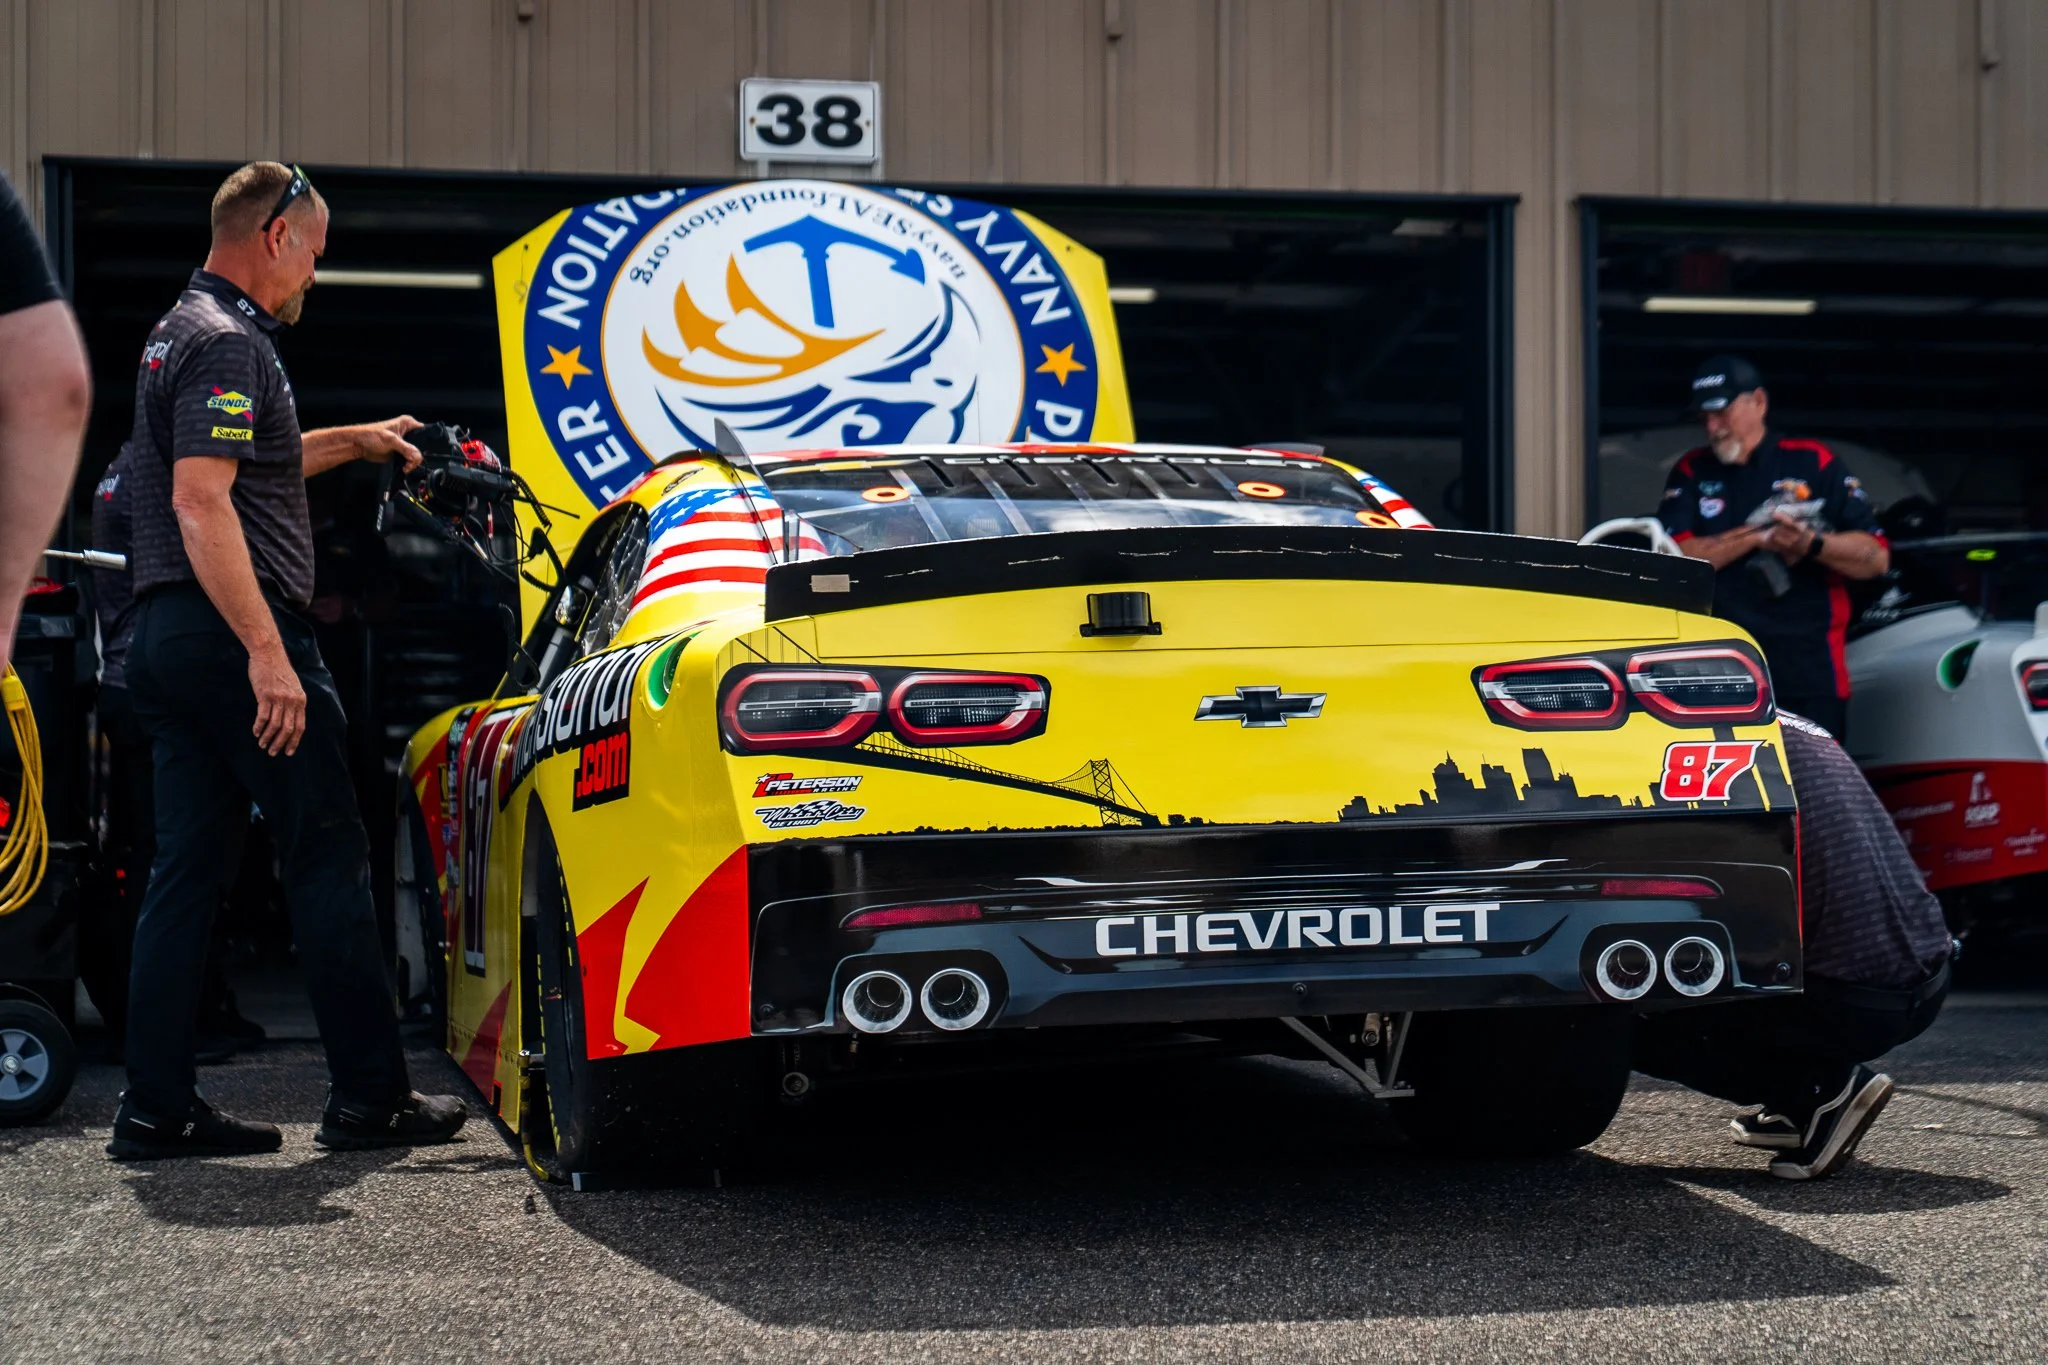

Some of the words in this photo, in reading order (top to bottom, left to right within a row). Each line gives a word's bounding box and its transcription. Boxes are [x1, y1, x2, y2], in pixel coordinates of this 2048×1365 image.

[756, 92, 863, 148] 38
[955, 210, 1072, 326] NAVY
[236, 298, 256, 317] 87
[576, 732, 628, 799] .com
[765, 776, 863, 792] PETERSON
[1660, 740, 1766, 801] 87
[771, 820, 819, 828] DETROIT
[1095, 902, 1500, 957] CHEVROLET
